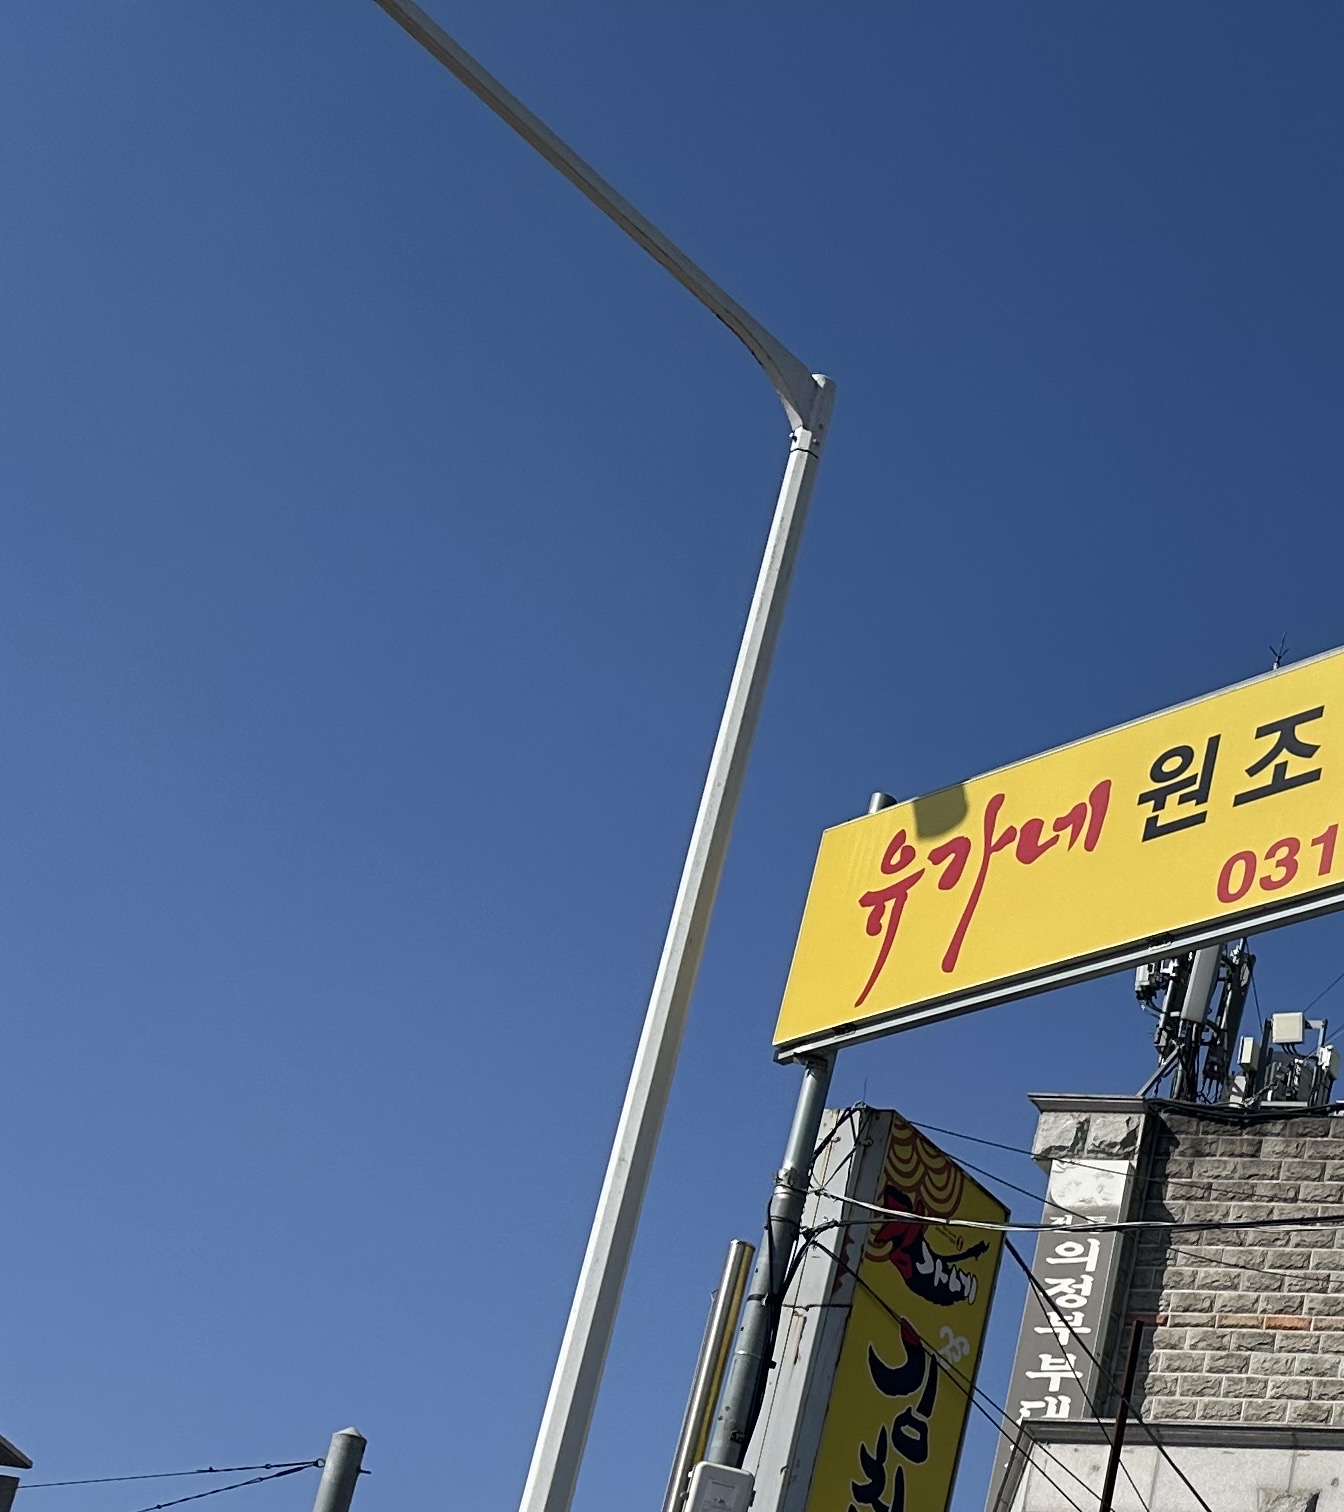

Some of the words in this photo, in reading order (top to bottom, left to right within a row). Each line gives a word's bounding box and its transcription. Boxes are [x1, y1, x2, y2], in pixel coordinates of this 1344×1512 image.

[855, 778, 1112, 1007] 유가네
[1137, 704, 1326, 842] 원조
[1033, 1238, 1101, 1346] 의정부
